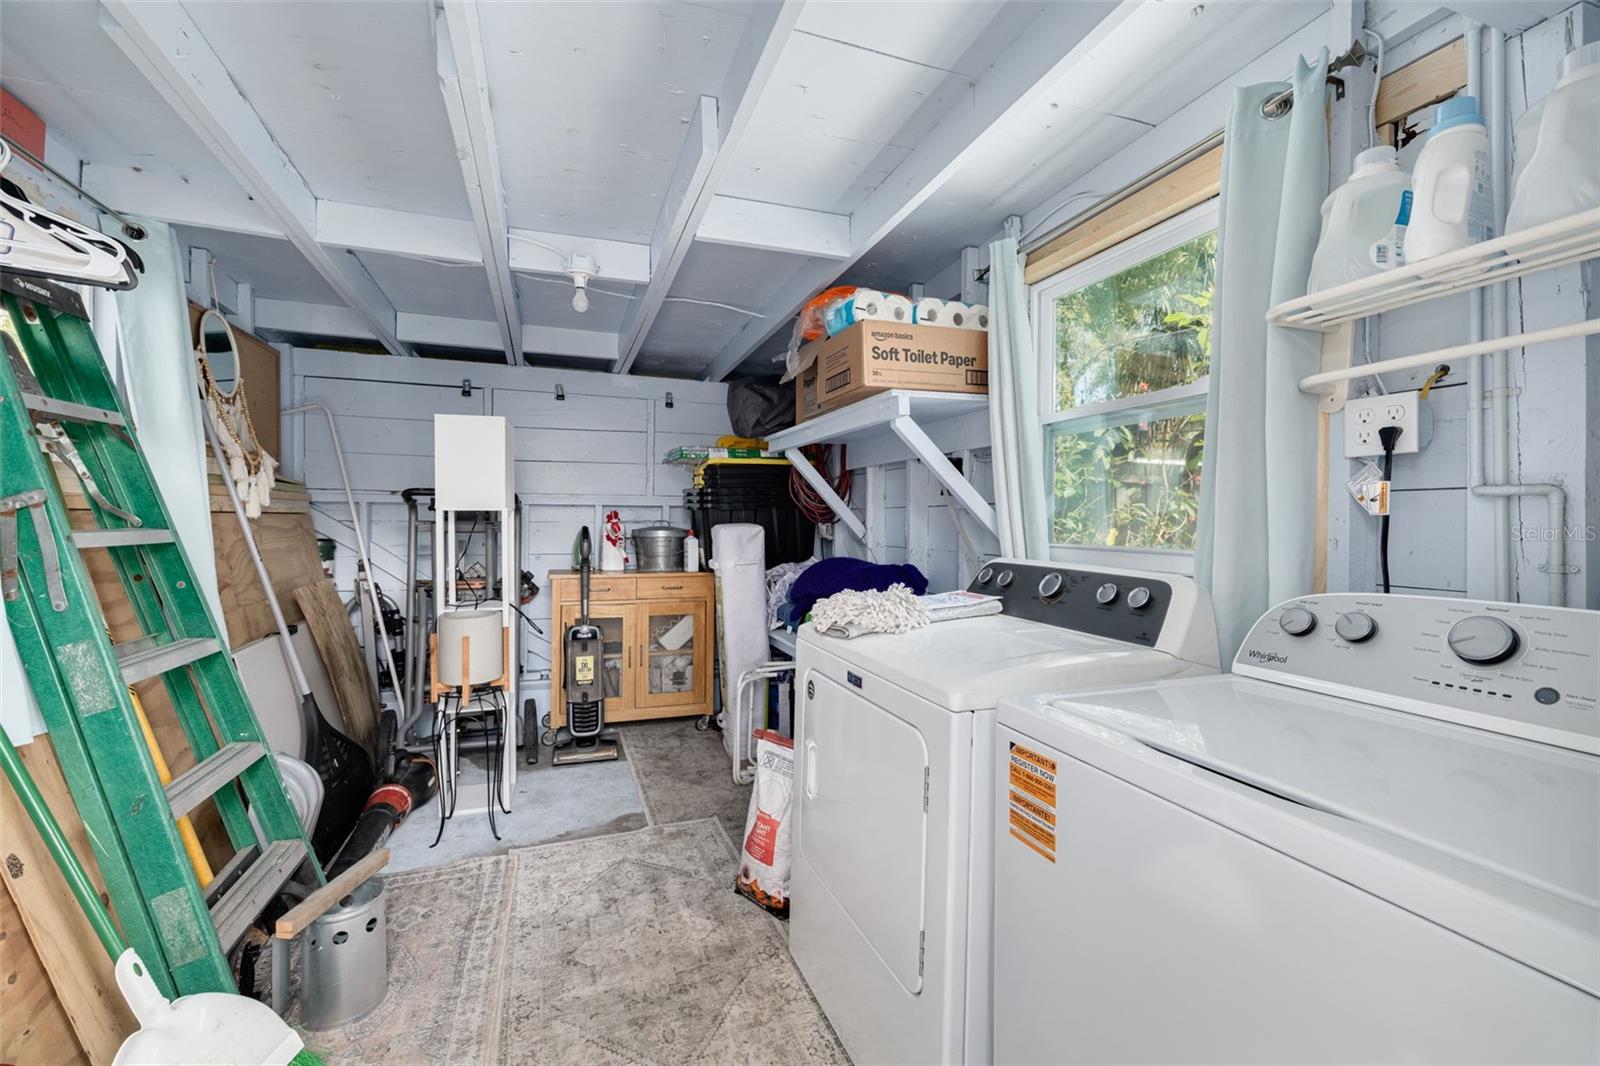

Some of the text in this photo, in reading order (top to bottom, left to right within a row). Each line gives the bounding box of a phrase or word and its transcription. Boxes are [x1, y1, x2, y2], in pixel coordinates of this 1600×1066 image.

[871, 330, 914, 341] amazon basics
[871, 345, 977, 369] Soft Toilet Paper
[1248, 648, 1289, 665] Whirlpool
[1010, 754, 1055, 783] REGISTER NOW
